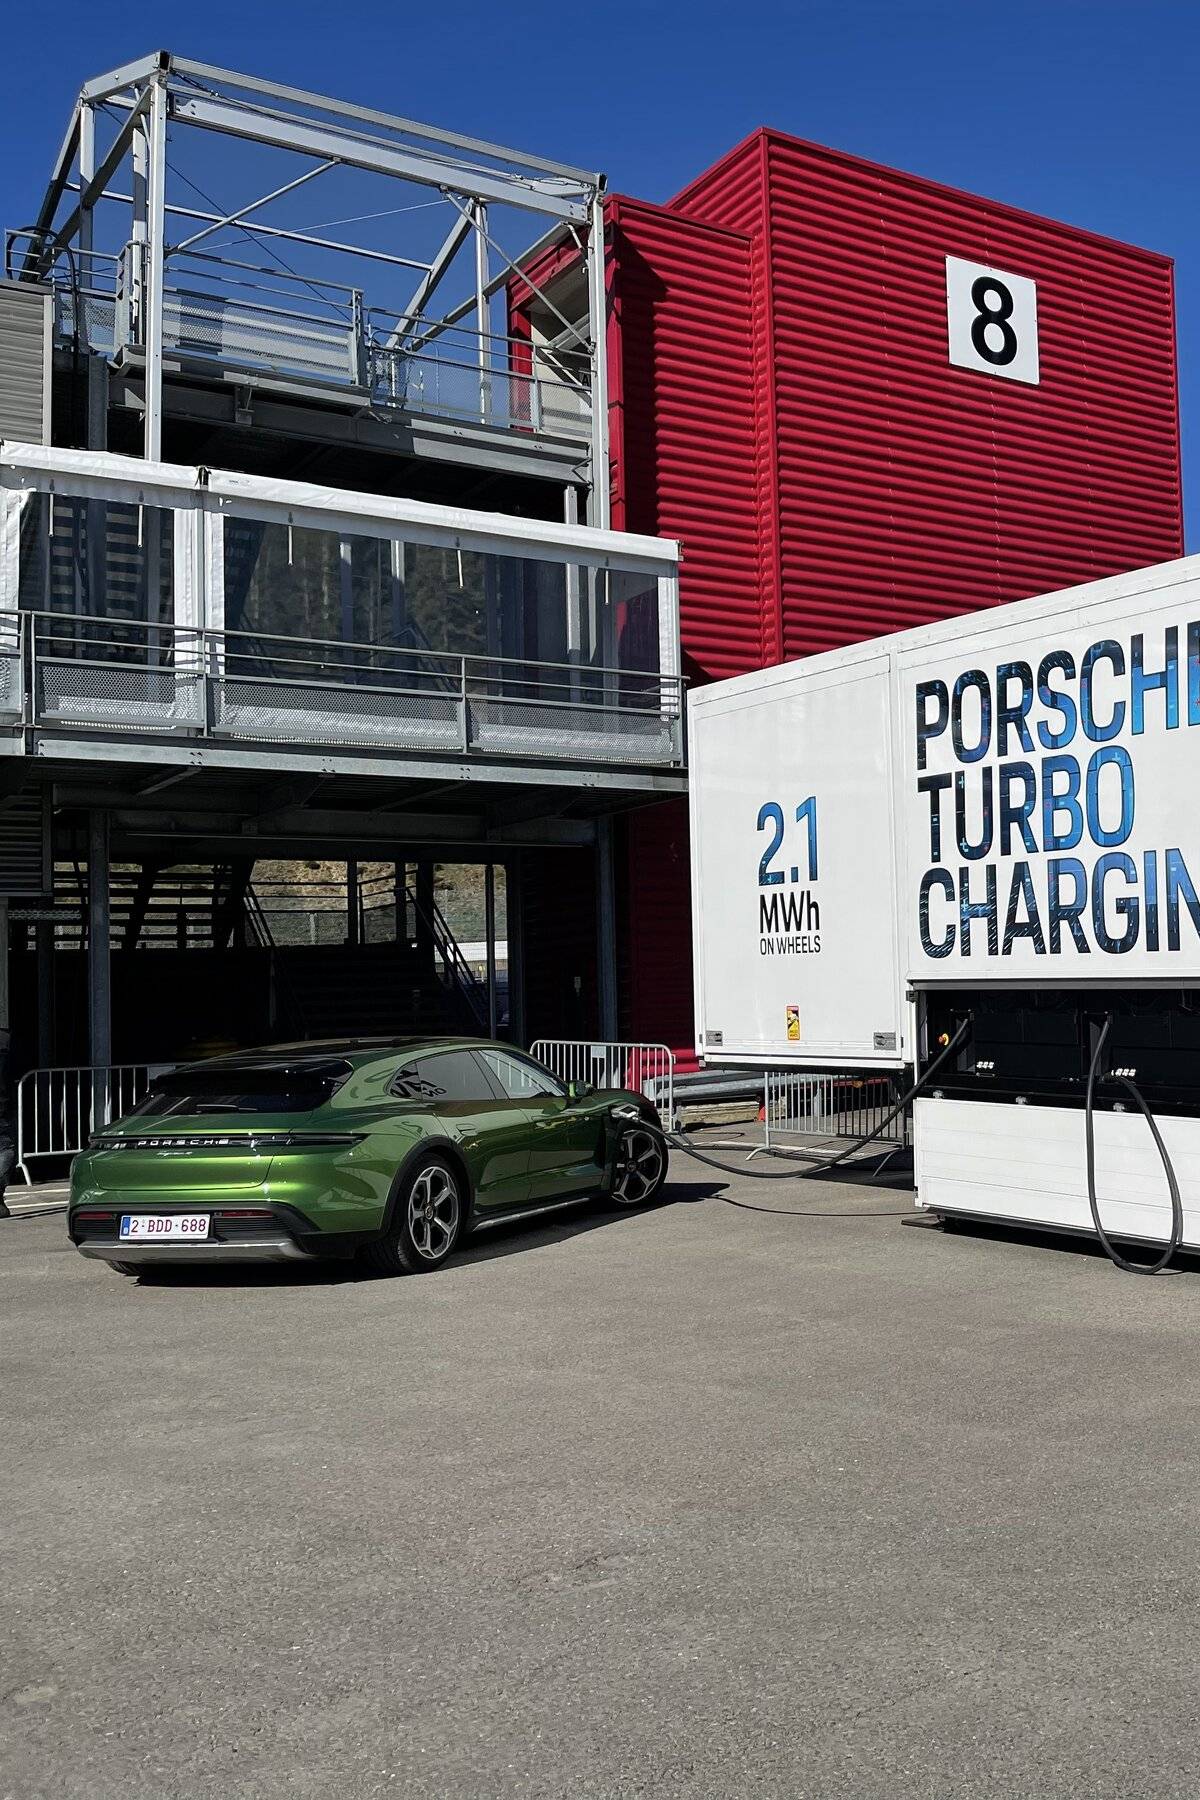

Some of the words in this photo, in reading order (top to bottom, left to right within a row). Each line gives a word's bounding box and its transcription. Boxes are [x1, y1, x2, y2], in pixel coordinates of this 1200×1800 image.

[971, 276, 1017, 366] 8
[757, 796, 818, 886] 2.1
[917, 745, 1135, 863] TURBO
[760, 890, 820, 934] MWh
[760, 939, 775, 955] ON
[777, 935, 821, 954] WHEELS
